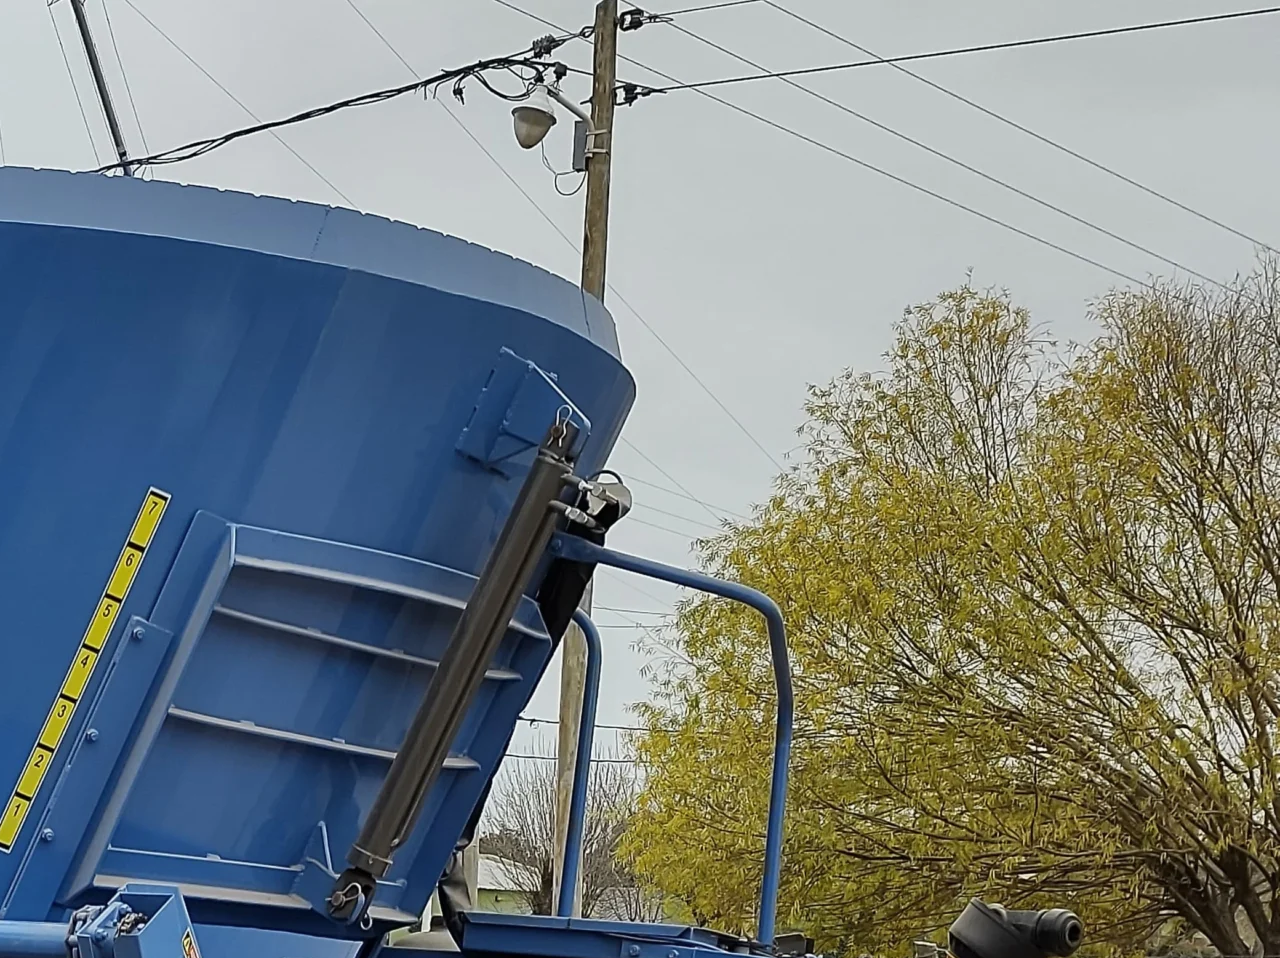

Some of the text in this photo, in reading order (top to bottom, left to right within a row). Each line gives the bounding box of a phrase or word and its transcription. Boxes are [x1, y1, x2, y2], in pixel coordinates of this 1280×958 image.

[147, 501, 158, 515] 7
[125, 553, 135, 567] 6
[103, 604, 113, 618] 5
[81, 654, 90, 669] 4
[58, 704, 68, 718] 3
[34, 754, 45, 768] 2
[13, 803, 21, 817] 1
